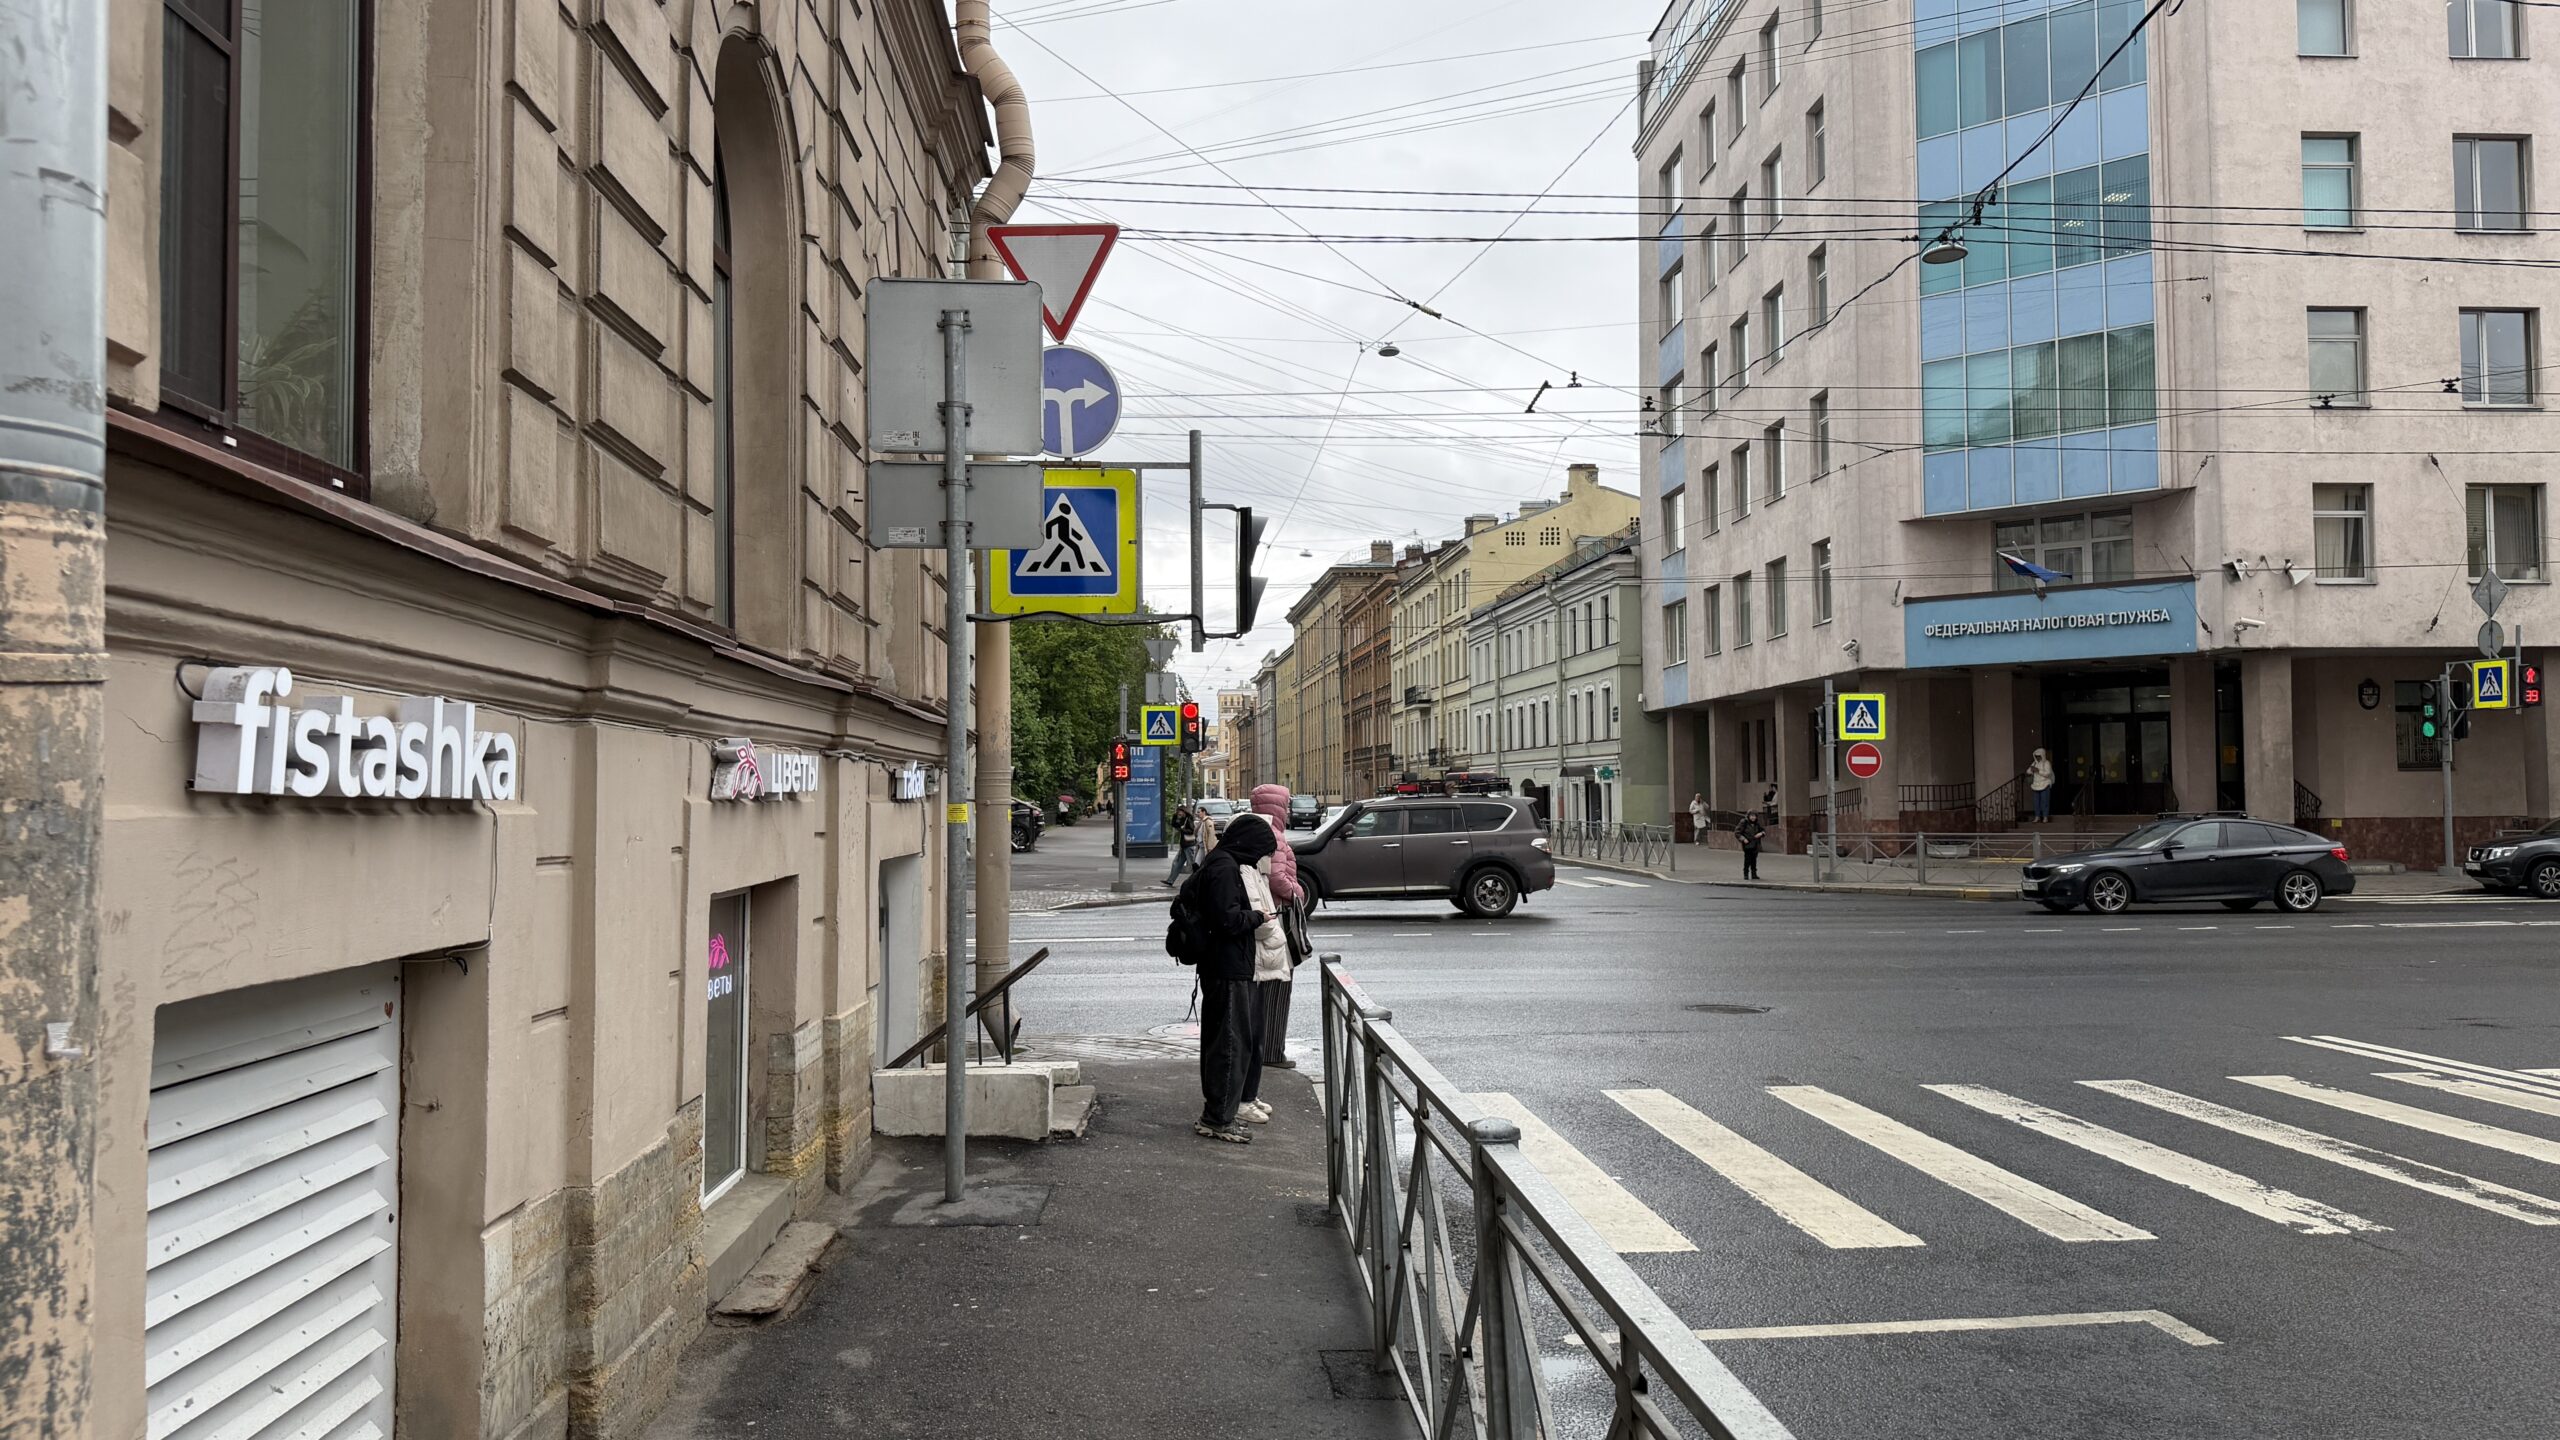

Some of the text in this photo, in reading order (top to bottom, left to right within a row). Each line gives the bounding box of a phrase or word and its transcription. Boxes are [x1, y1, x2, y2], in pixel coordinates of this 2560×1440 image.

[1924, 608, 2172, 638] ФЕДЕРАЛЬНАЯ НАЛОГОВАЯ СЛУЖБА
[228, 666, 517, 800] fistashka
[1188, 722, 1197, 732] 12
